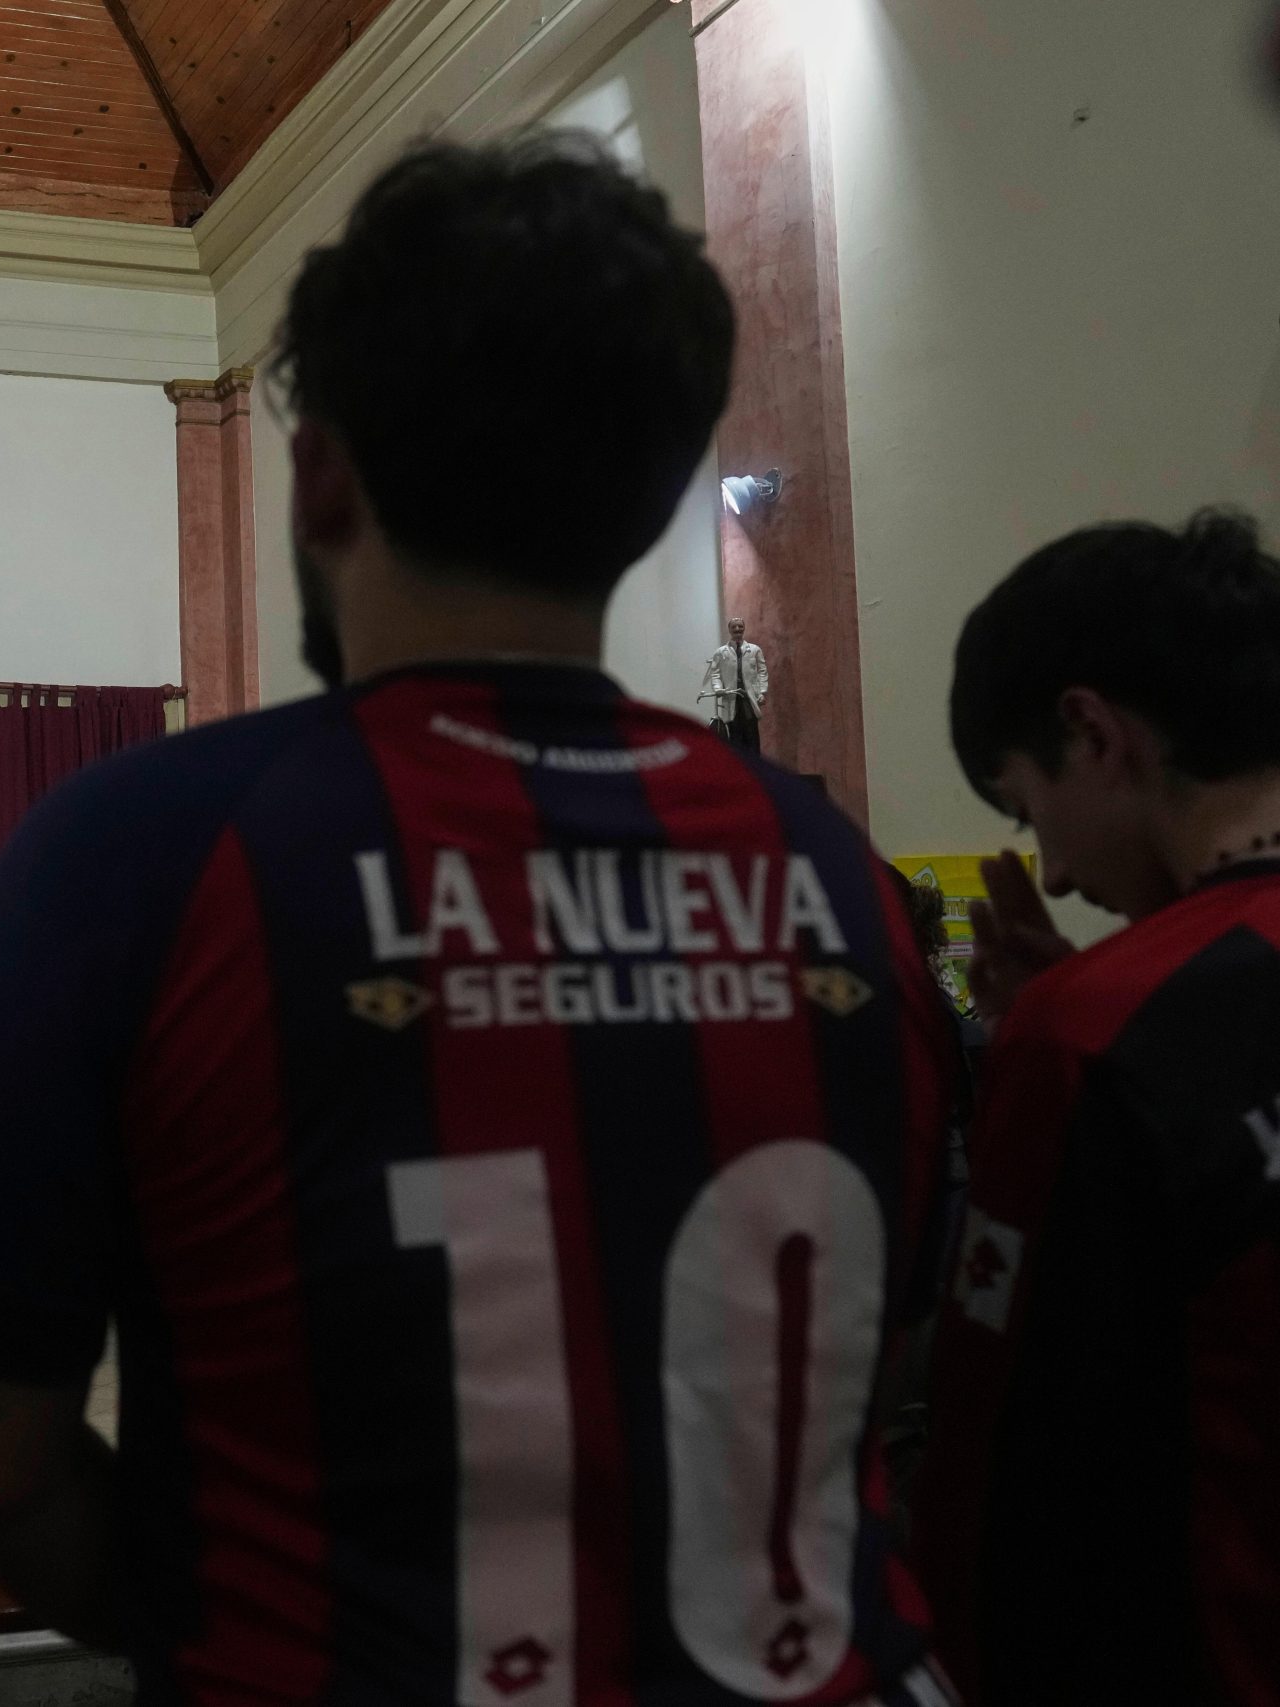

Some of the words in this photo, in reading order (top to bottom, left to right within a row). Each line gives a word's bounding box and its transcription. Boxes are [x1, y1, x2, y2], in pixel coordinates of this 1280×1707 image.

[354, 849, 500, 960] LA
[527, 849, 848, 955] NUEVA
[442, 961, 795, 1029] SEGUROS
[386, 1138, 886, 1706] 10
